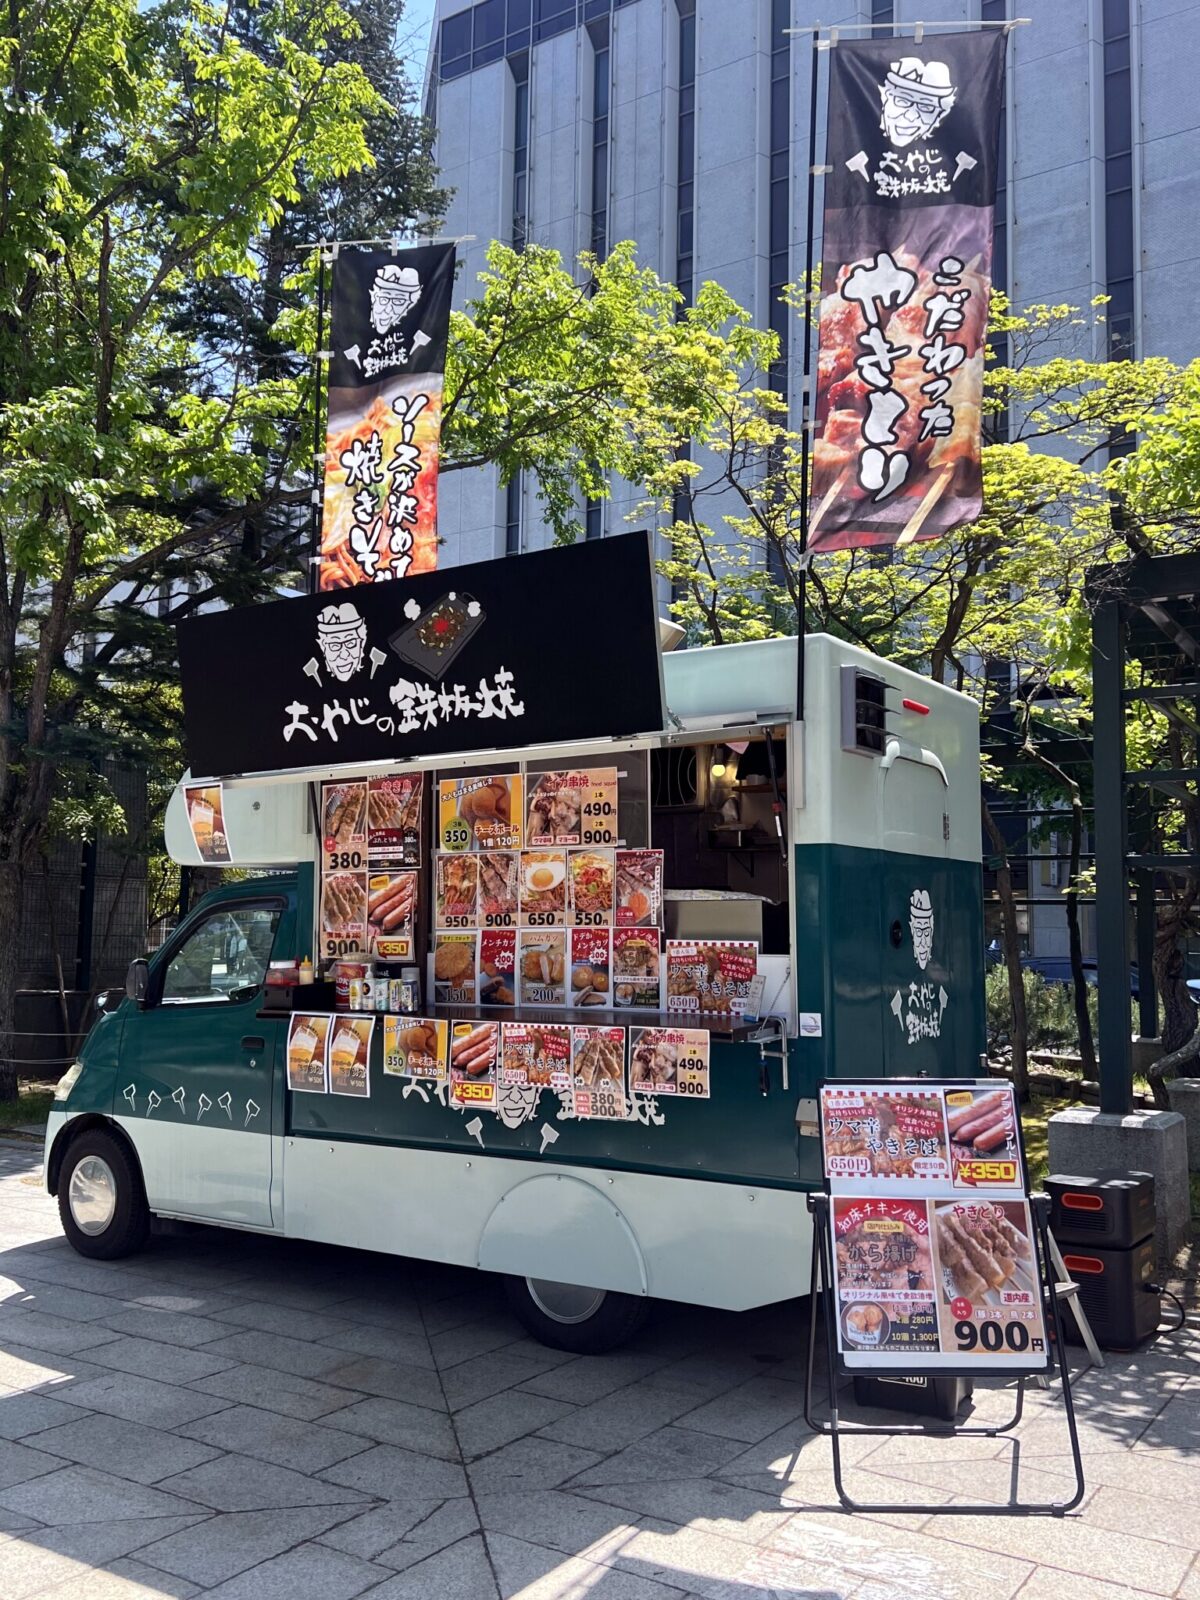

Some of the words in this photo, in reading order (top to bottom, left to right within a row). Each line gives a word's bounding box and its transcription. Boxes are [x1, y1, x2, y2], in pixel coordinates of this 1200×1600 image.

[878, 149, 943, 173] おやじの
[873, 169, 951, 199] 鉄板焼
[367, 332, 404, 355] おやじの
[918, 255, 971, 443] こだわった
[362, 348, 408, 378] 鉄板焼
[841, 251, 918, 502] やきとり
[283, 666, 525, 742] おやじの鉄板焼
[550, 775, 589, 789] イカ串焼
[445, 830, 468, 843] 350
[475, 824, 519, 836] チーズボール
[482, 938, 515, 947] メンチカツ
[529, 934, 559, 943] ハムカツ
[576, 939, 609, 951] メンチカツ
[378, 942, 407, 954] ¥350
[671, 963, 708, 978] ウマ辛
[696, 981, 751, 996] やきそば
[670, 997, 698, 1008] 650円
[905, 1009, 941, 1045] 鉄板焼
[651, 1033, 685, 1044] イカ串焼
[387, 1056, 404, 1067] 350
[455, 1083, 493, 1099] ¥350
[829, 1108, 873, 1116] 気持ちいい辛さ
[895, 1105, 939, 1117] オリジナル風味
[829, 1117, 879, 1135] ウマ辛
[898, 1118, 936, 1128] 一度食べたら
[901, 1125, 933, 1135] とまらない
[1001, 1091, 1016, 1160] フランクフルト
[867, 1138, 938, 1155] やきそば
[830, 1158, 868, 1171] 650円
[960, 1162, 1015, 1179] ¥350
[837, 1202, 928, 1233] 知床チキン使用
[953, 1205, 1004, 1219] やきとり
[848, 1243, 918, 1263] から揚げ
